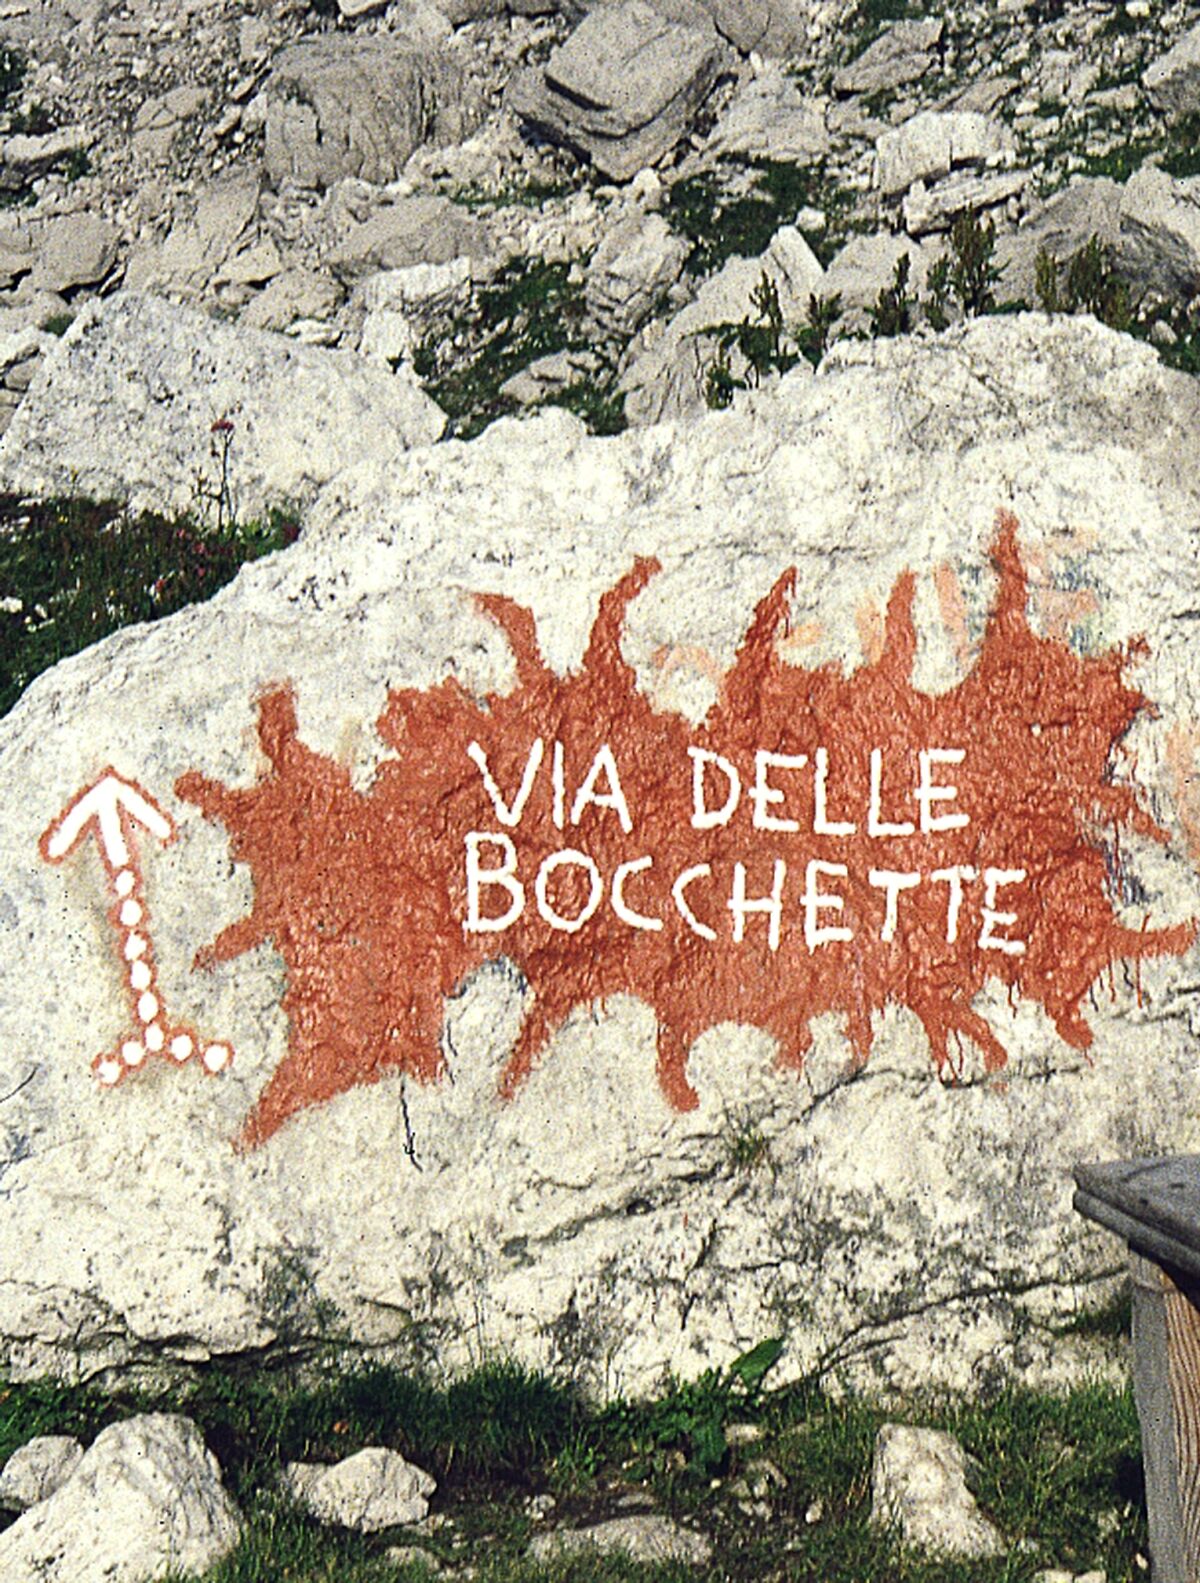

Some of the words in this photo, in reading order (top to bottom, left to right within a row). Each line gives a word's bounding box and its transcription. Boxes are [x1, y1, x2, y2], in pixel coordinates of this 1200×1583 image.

[467, 737, 633, 834] VIA
[686, 746, 970, 838] DELLE
[461, 830, 1028, 955] BOCCHETTE
